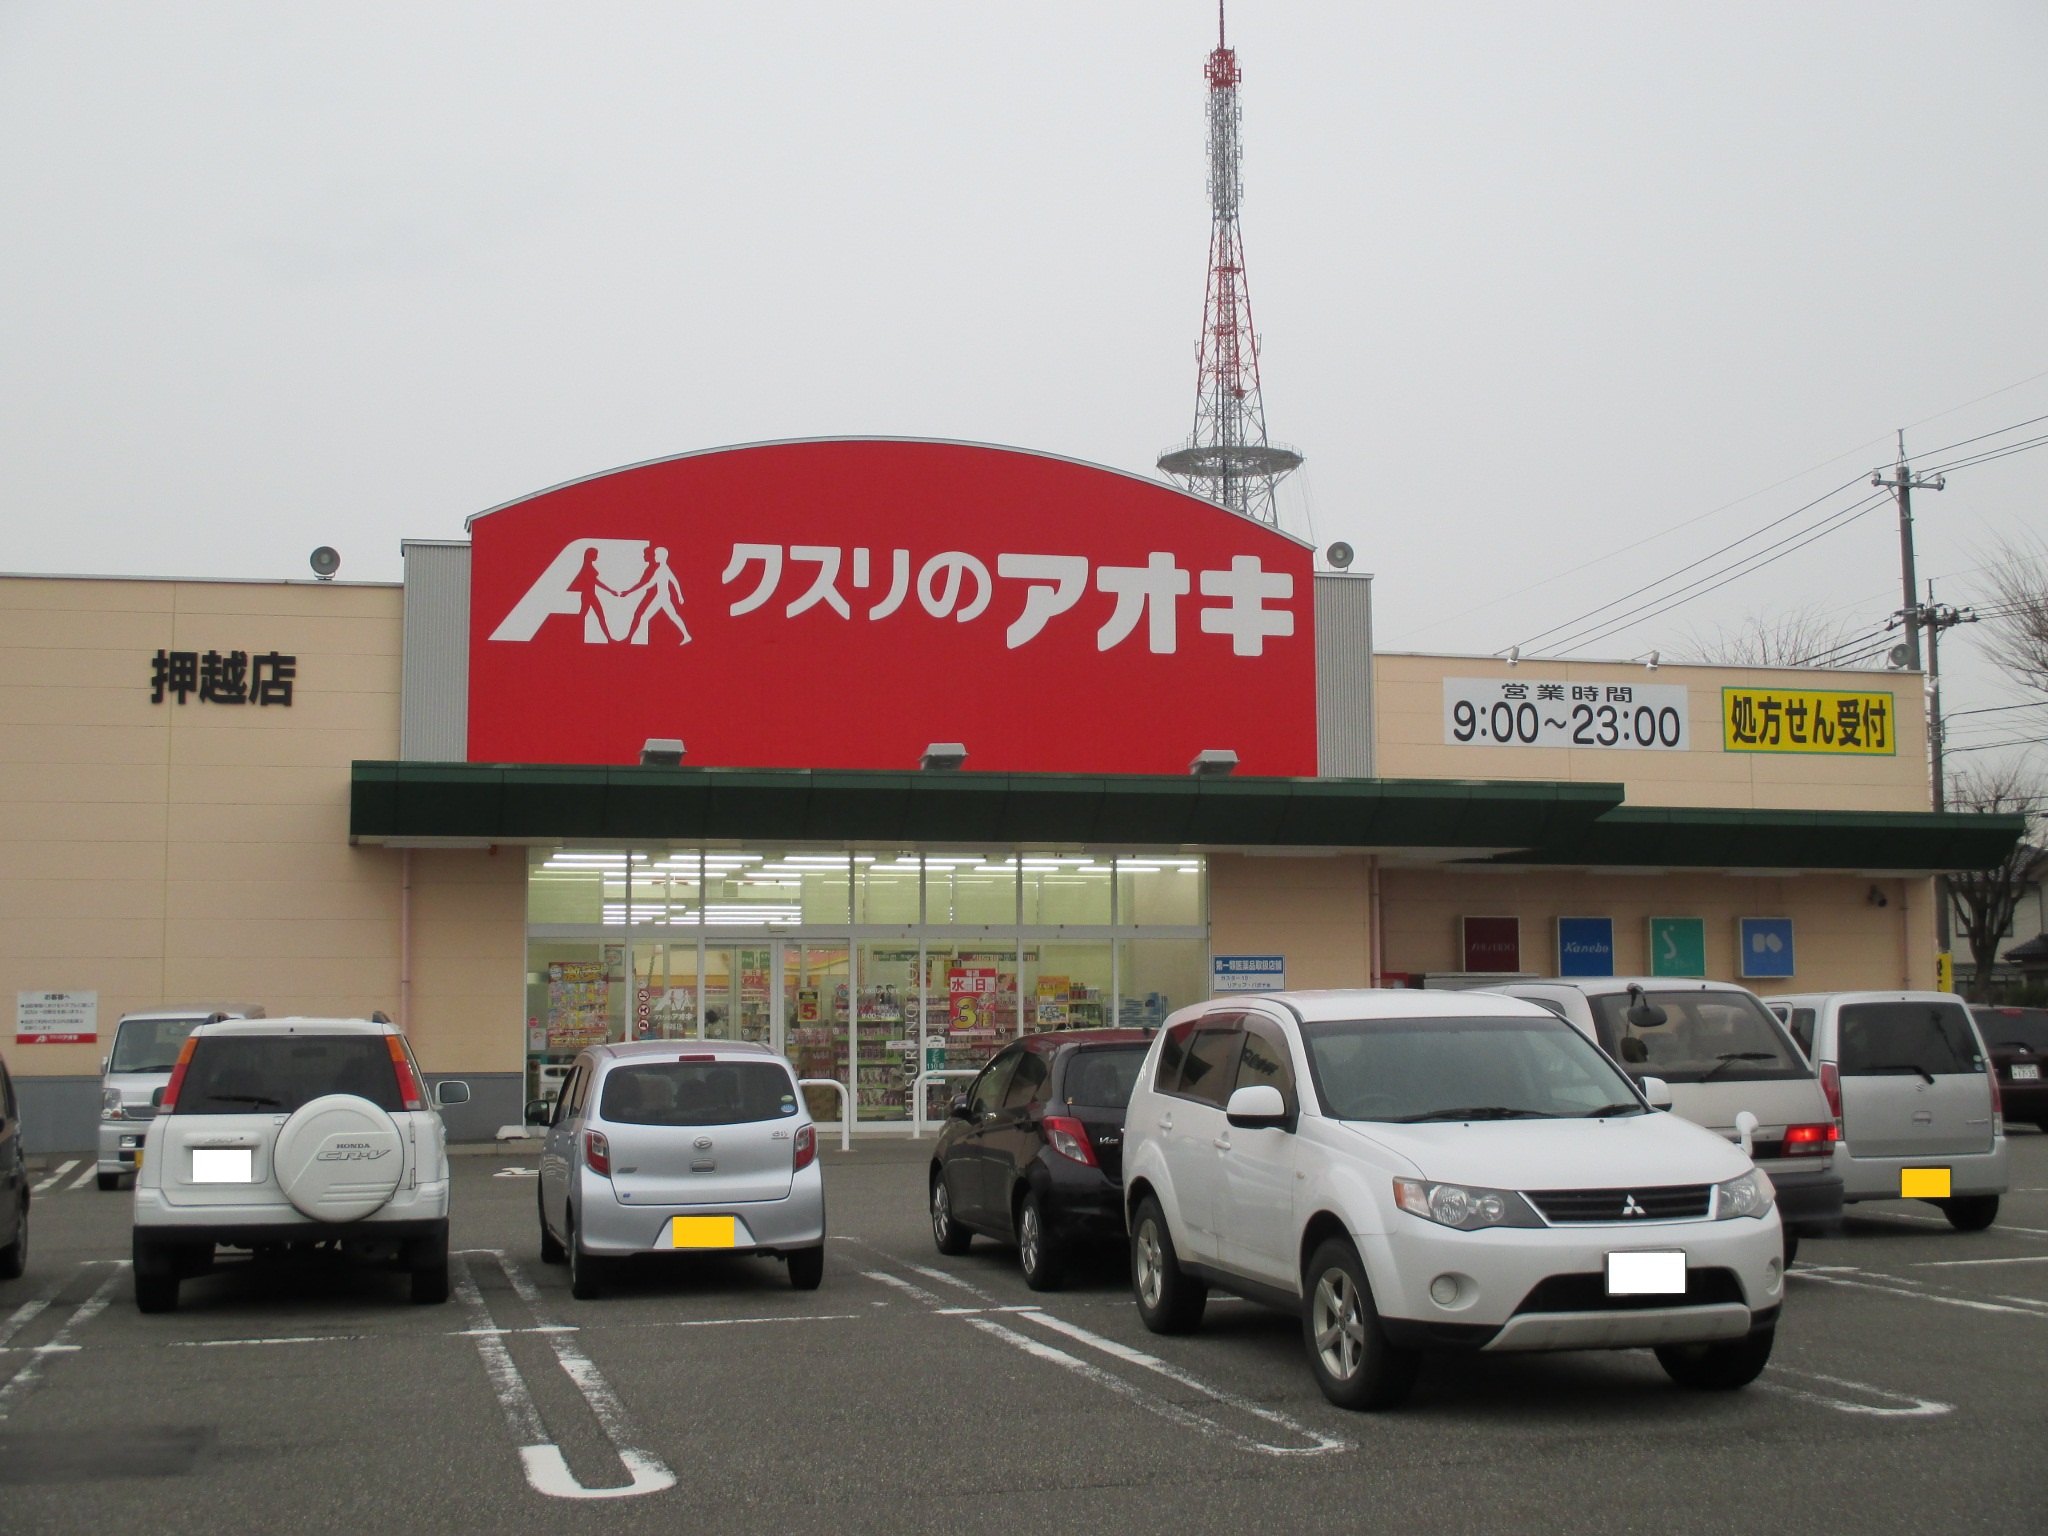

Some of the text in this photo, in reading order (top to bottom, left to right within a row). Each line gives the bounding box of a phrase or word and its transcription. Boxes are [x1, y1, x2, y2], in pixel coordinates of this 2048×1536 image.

[722, 541, 1295, 657] クスリのアオキ
[151, 649, 297, 707] 押越店
[1501, 681, 1634, 704] 営業時間
[1730, 694, 1887, 749] 処方せん受付
[1563, 941, 1609, 953] Kanebo
[316, 1149, 392, 1161] CR-V
